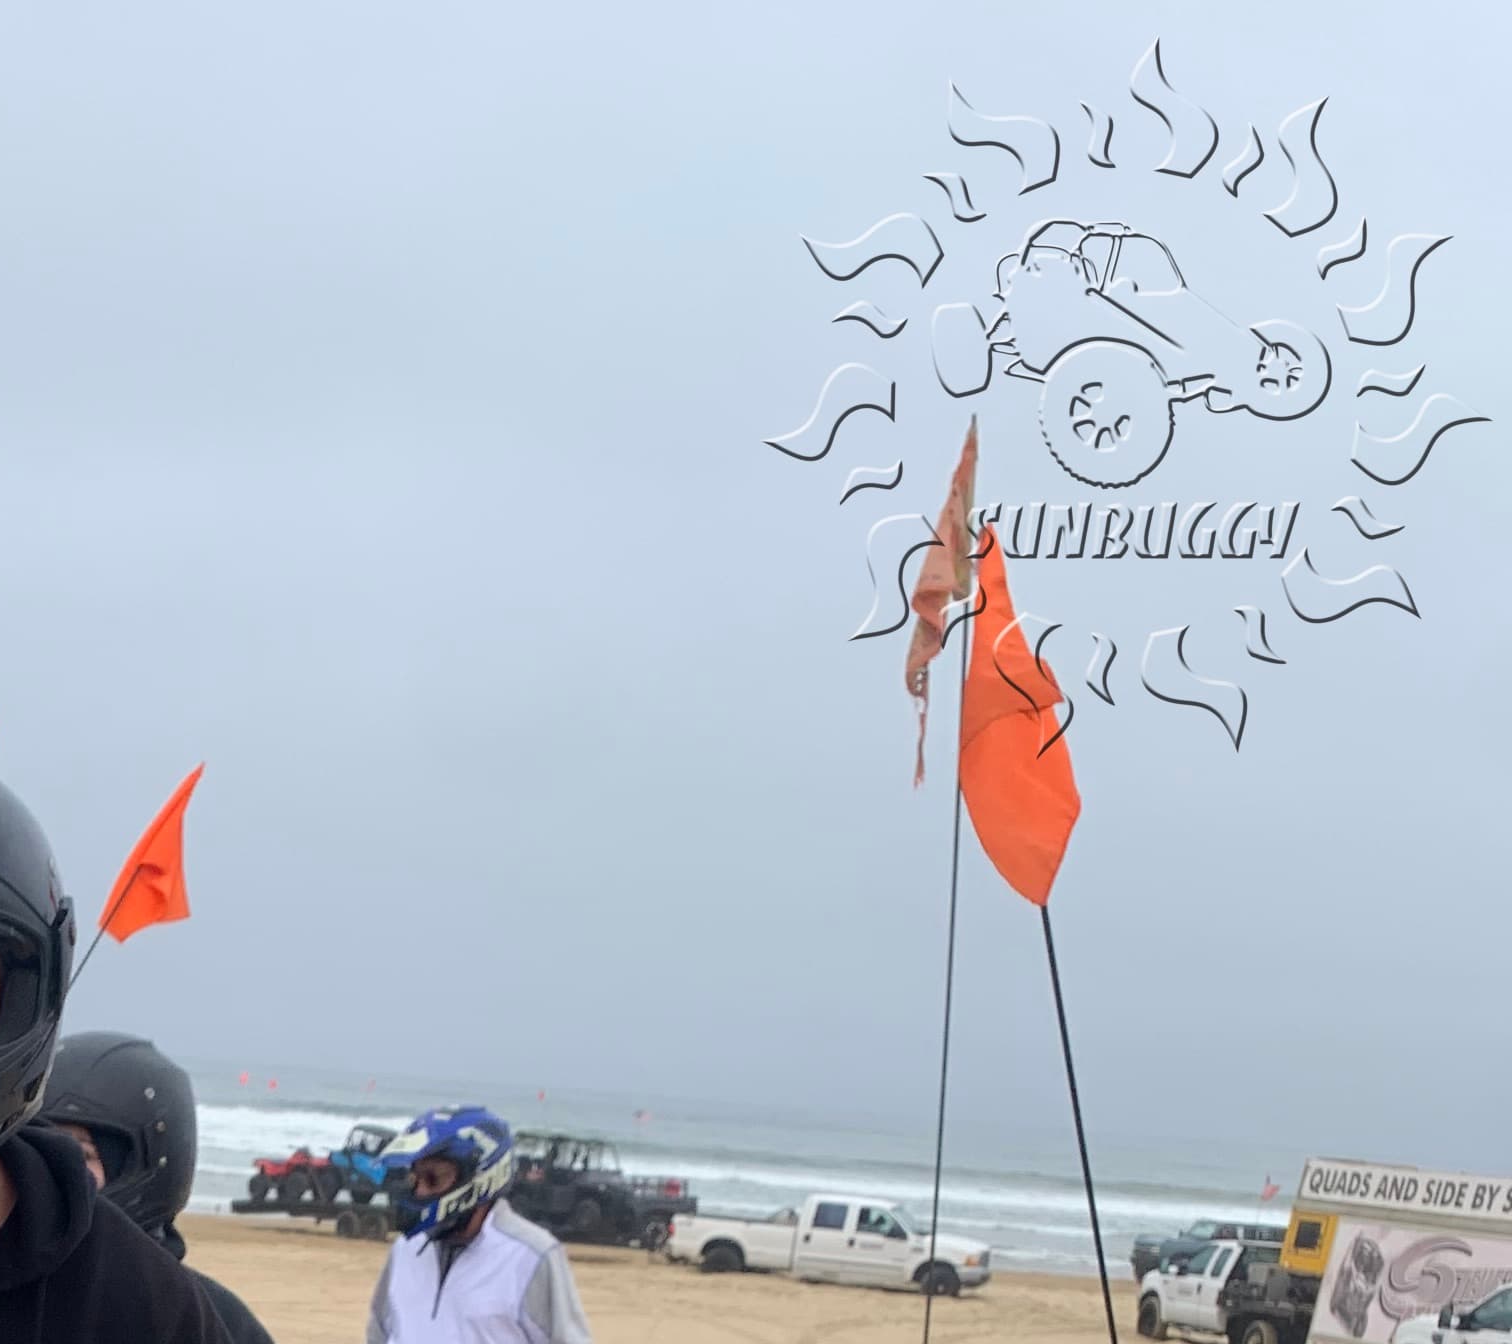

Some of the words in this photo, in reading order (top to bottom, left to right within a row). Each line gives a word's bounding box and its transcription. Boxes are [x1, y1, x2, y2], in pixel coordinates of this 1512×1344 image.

[1309, 1167, 1372, 1198] QUADS
[1374, 1175, 1419, 1203] AND
[1422, 1179, 1469, 1209] SIDE
[1471, 1184, 1501, 1213] BY
